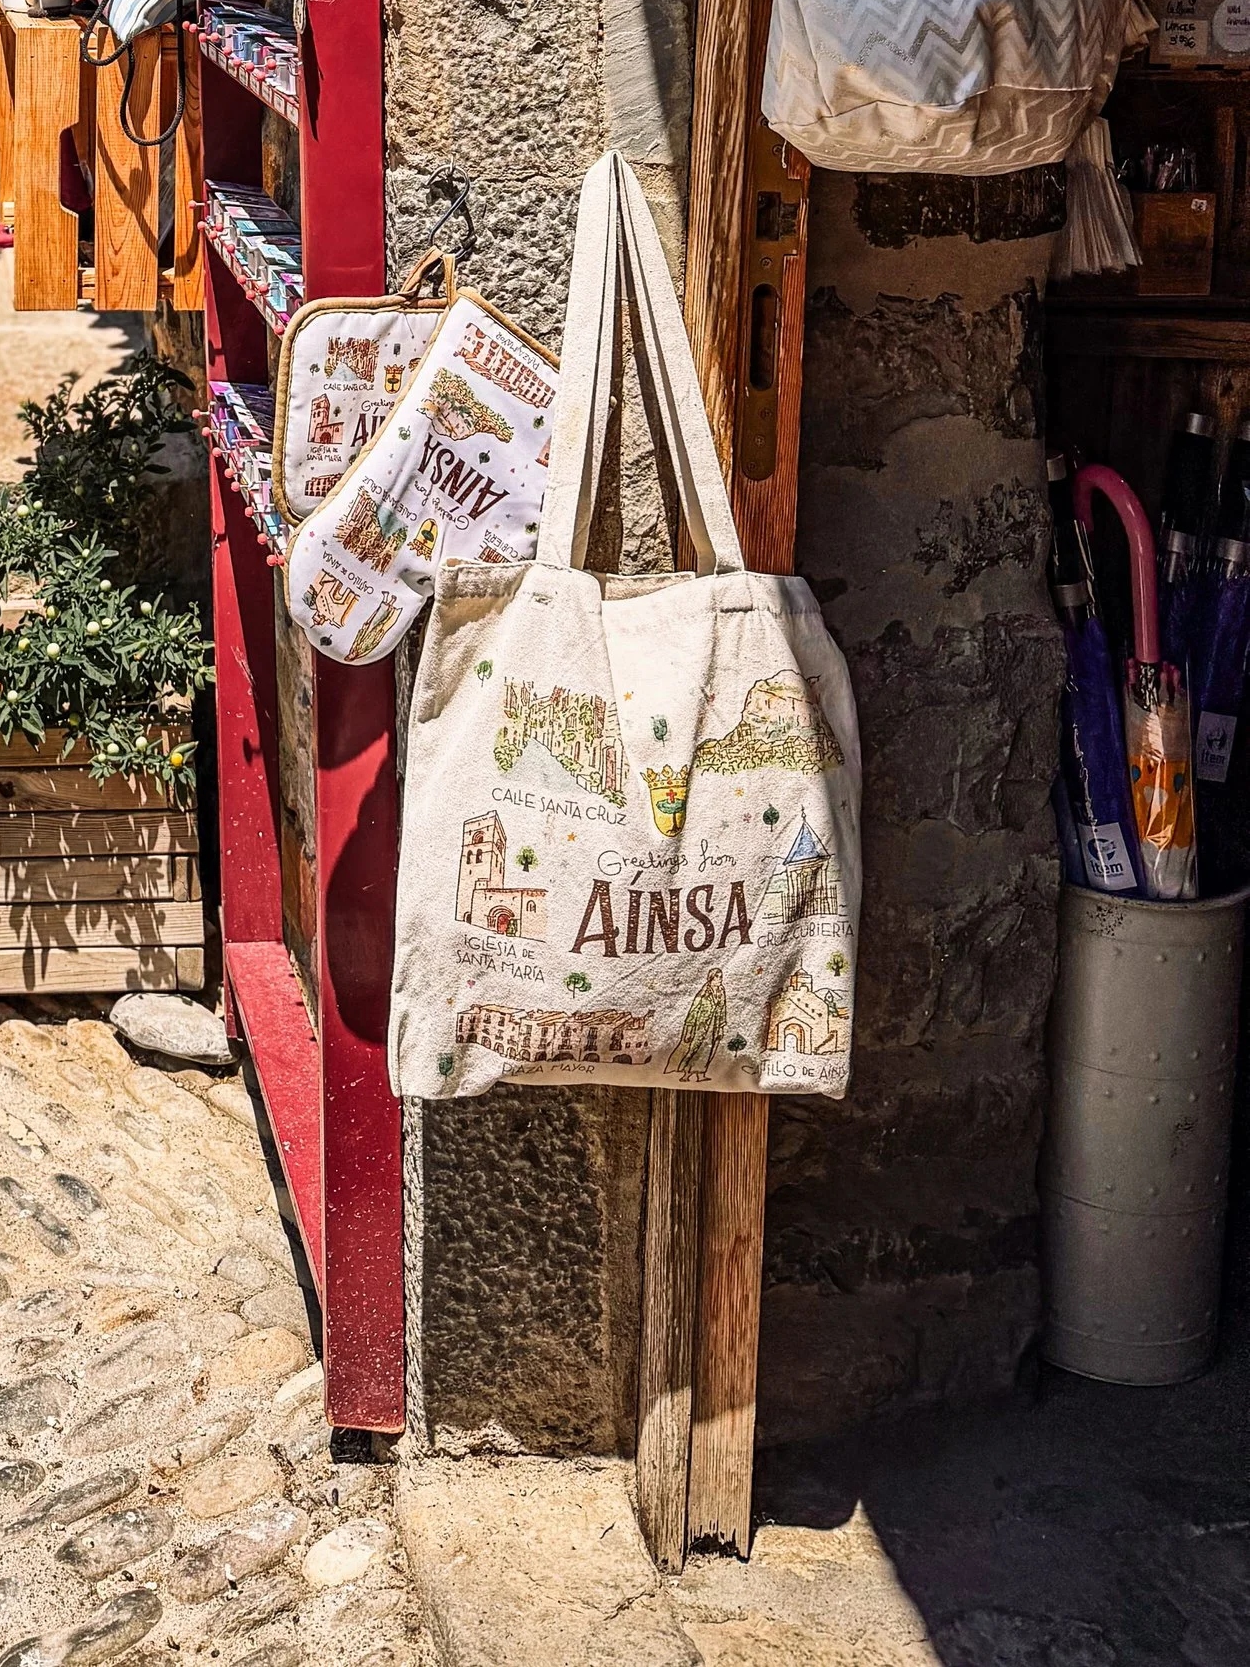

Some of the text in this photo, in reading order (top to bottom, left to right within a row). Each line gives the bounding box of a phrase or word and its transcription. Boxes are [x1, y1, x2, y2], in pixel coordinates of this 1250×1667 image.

[361, 398, 395, 412] Greeting
[417, 432, 511, 521] AÍNSA
[491, 787, 628, 826] CALLE SANTA CRUZ
[597, 838, 737, 876] Greetings from
[568, 870, 753, 958] AÍNSA
[455, 949, 545, 984] SANTA MARÍA
[522, 948, 535, 960] DE
[501, 1062, 544, 1077] PLAZA
[741, 1059, 796, 1077] CTILLO
[802, 1066, 815, 1077] DE
